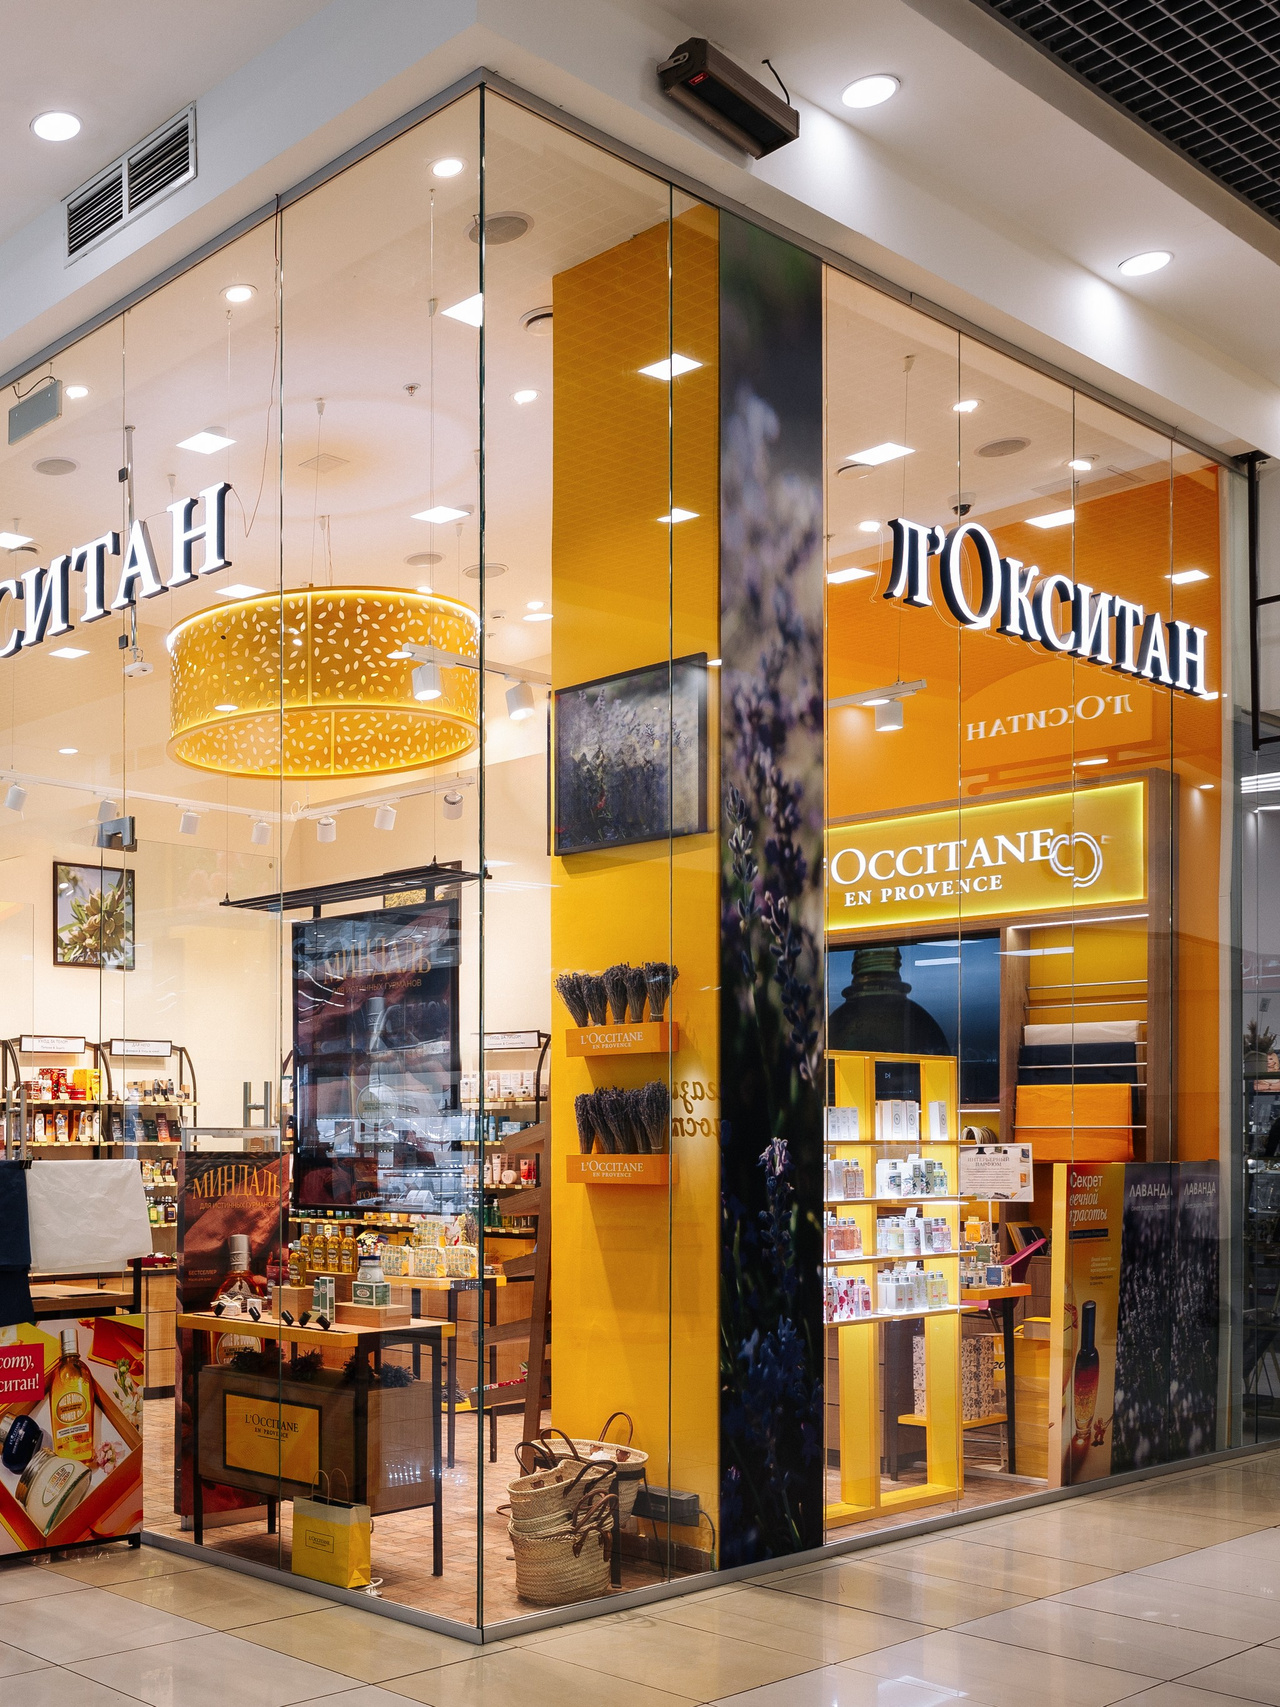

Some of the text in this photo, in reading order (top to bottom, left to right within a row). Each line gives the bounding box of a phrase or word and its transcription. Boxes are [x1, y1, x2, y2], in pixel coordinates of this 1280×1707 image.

[829, 828, 1055, 886] OCCITANE
[844, 874, 1003, 907] EN PROVENCE
[581, 1031, 644, 1045] L'OCCITANE
[581, 1160, 644, 1172] L'OCCITANE
[192, 1164, 281, 1200] МИНДАЛЬ
[1070, 1171, 1104, 1188] Секрет
[1129, 1183, 1173, 1199] ЛАВАНДА
[1183, 1181, 1217, 1196] ЛАВАНДА
[1069, 1189, 1099, 1207] вечной
[245, 1413, 299, 1433] L'OCCITANE
